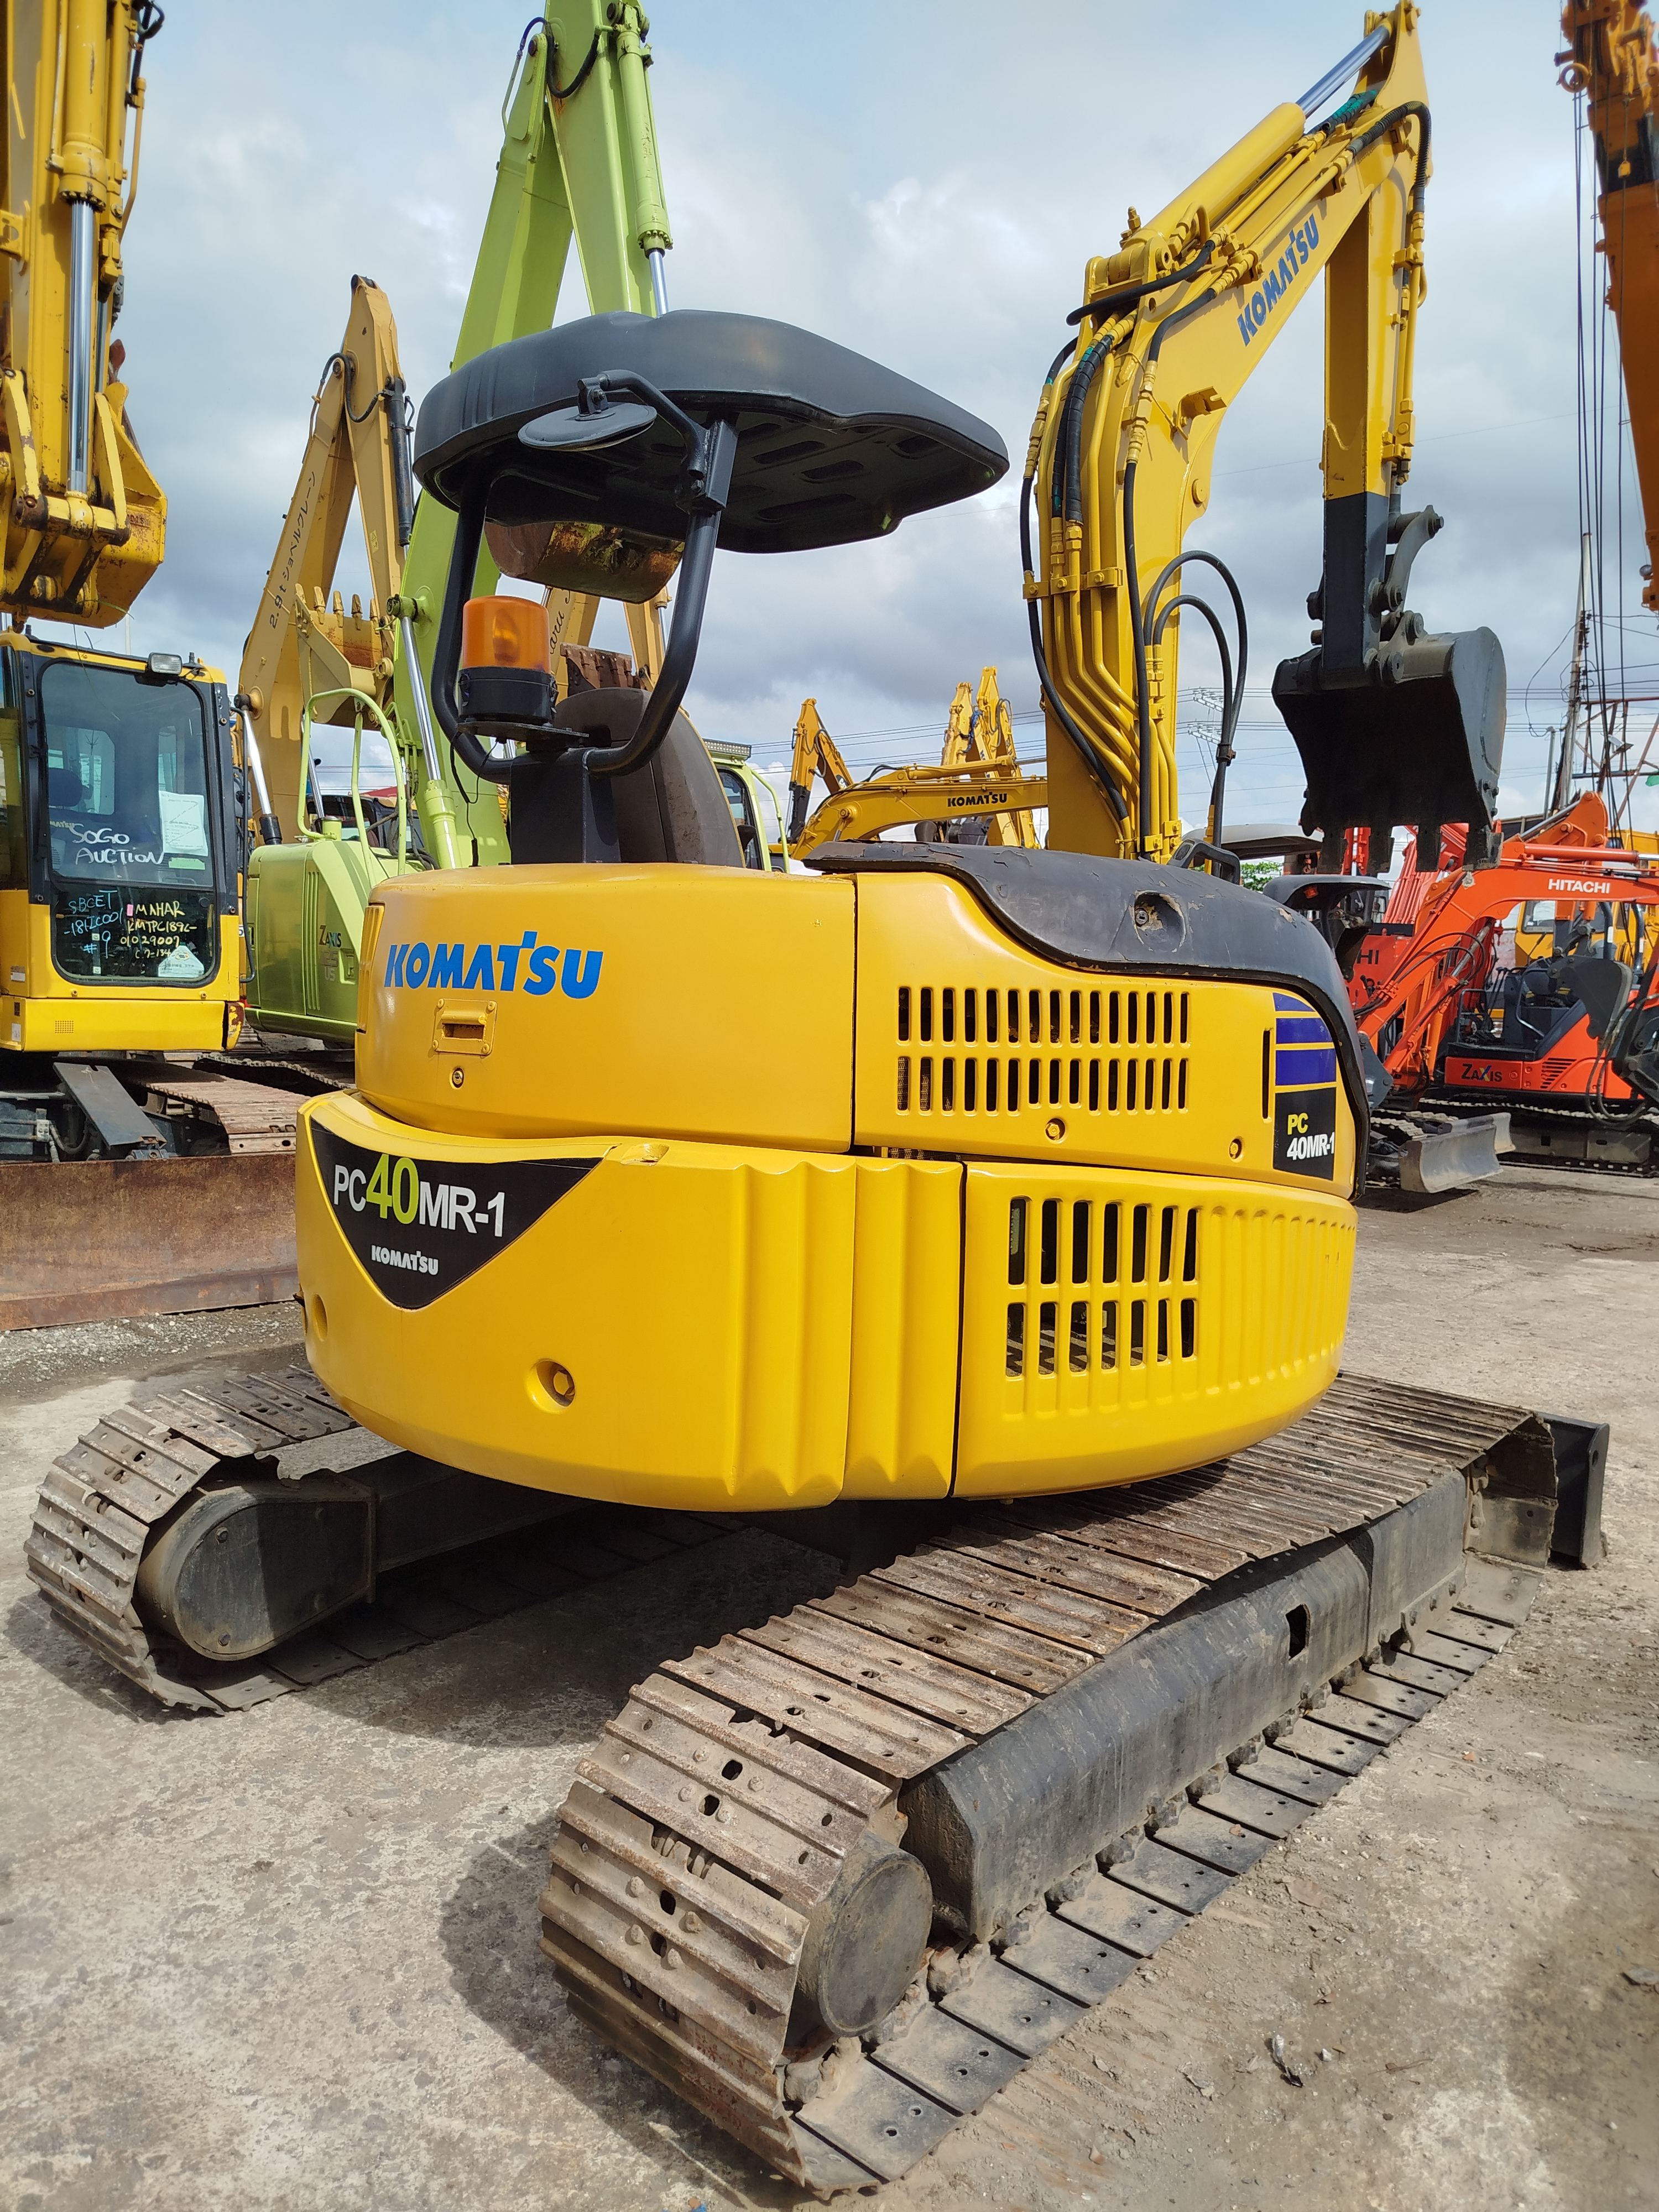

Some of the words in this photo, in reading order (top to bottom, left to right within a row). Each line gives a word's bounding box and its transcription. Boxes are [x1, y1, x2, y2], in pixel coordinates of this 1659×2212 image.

[1237, 213, 1319, 347] KOMATSU
[947, 791, 1008, 807] KOMATSU
[69, 823, 130, 844] SOGO
[75, 847, 165, 865] AUCTION
[1548, 878, 1610, 894] HITACHI
[135, 900, 186, 918] MAHAR
[384, 930, 604, 1000] KOMATSU
[1287, 1113, 1308, 1135] PC
[1286, 1131, 1335, 1161] 40MR-1
[333, 1154, 505, 1237] PC40MR-1
[372, 1245, 439, 1275] KOMATSU
